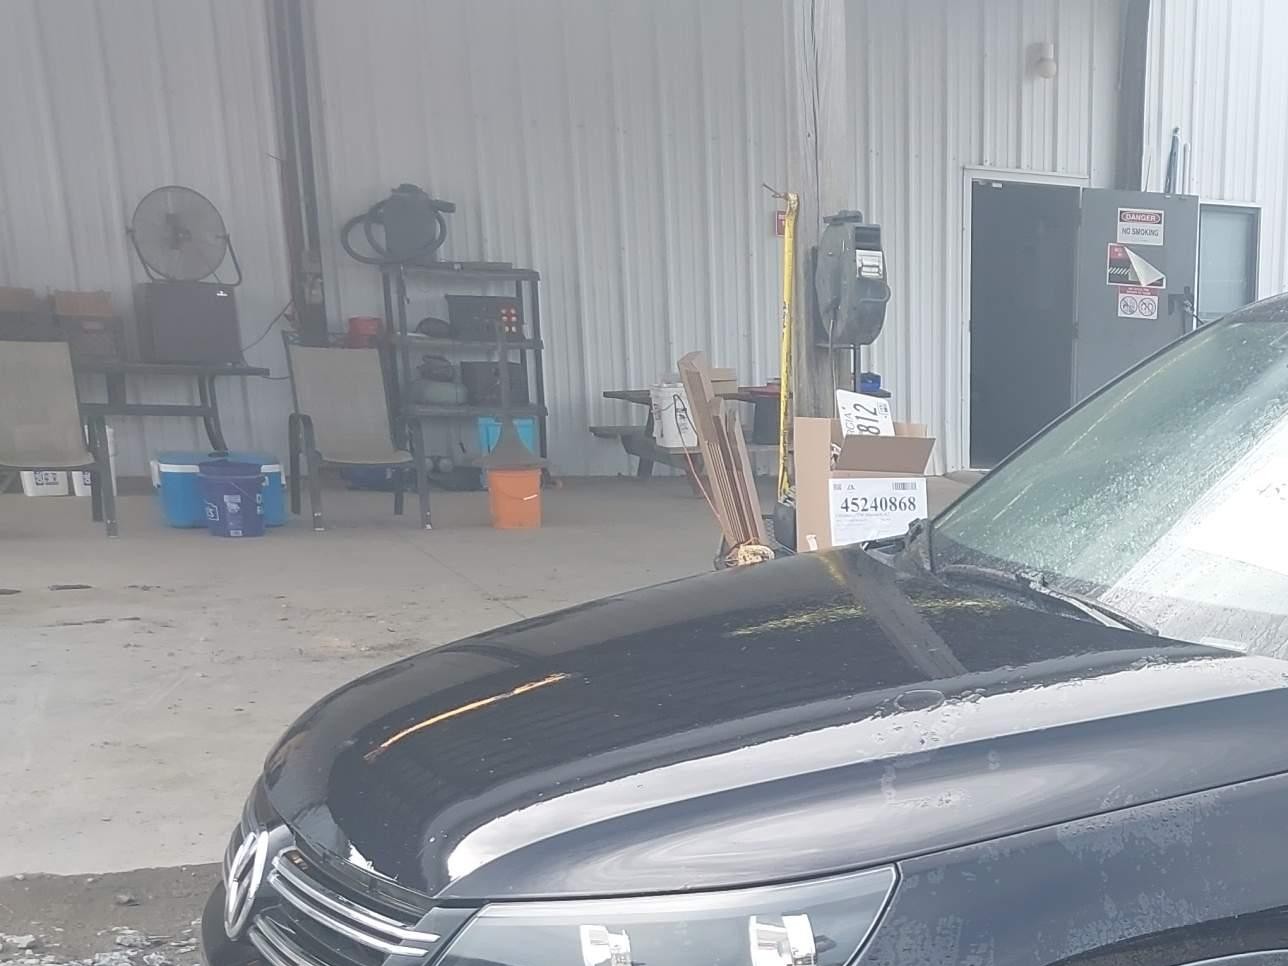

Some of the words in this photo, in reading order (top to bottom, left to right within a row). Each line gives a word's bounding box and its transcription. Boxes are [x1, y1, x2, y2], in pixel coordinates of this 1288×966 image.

[1125, 212, 1157, 222] DANGER
[1121, 228, 1131, 236] NO
[1131, 228, 1159, 237] SMOKING
[840, 496, 917, 513] 45240868
